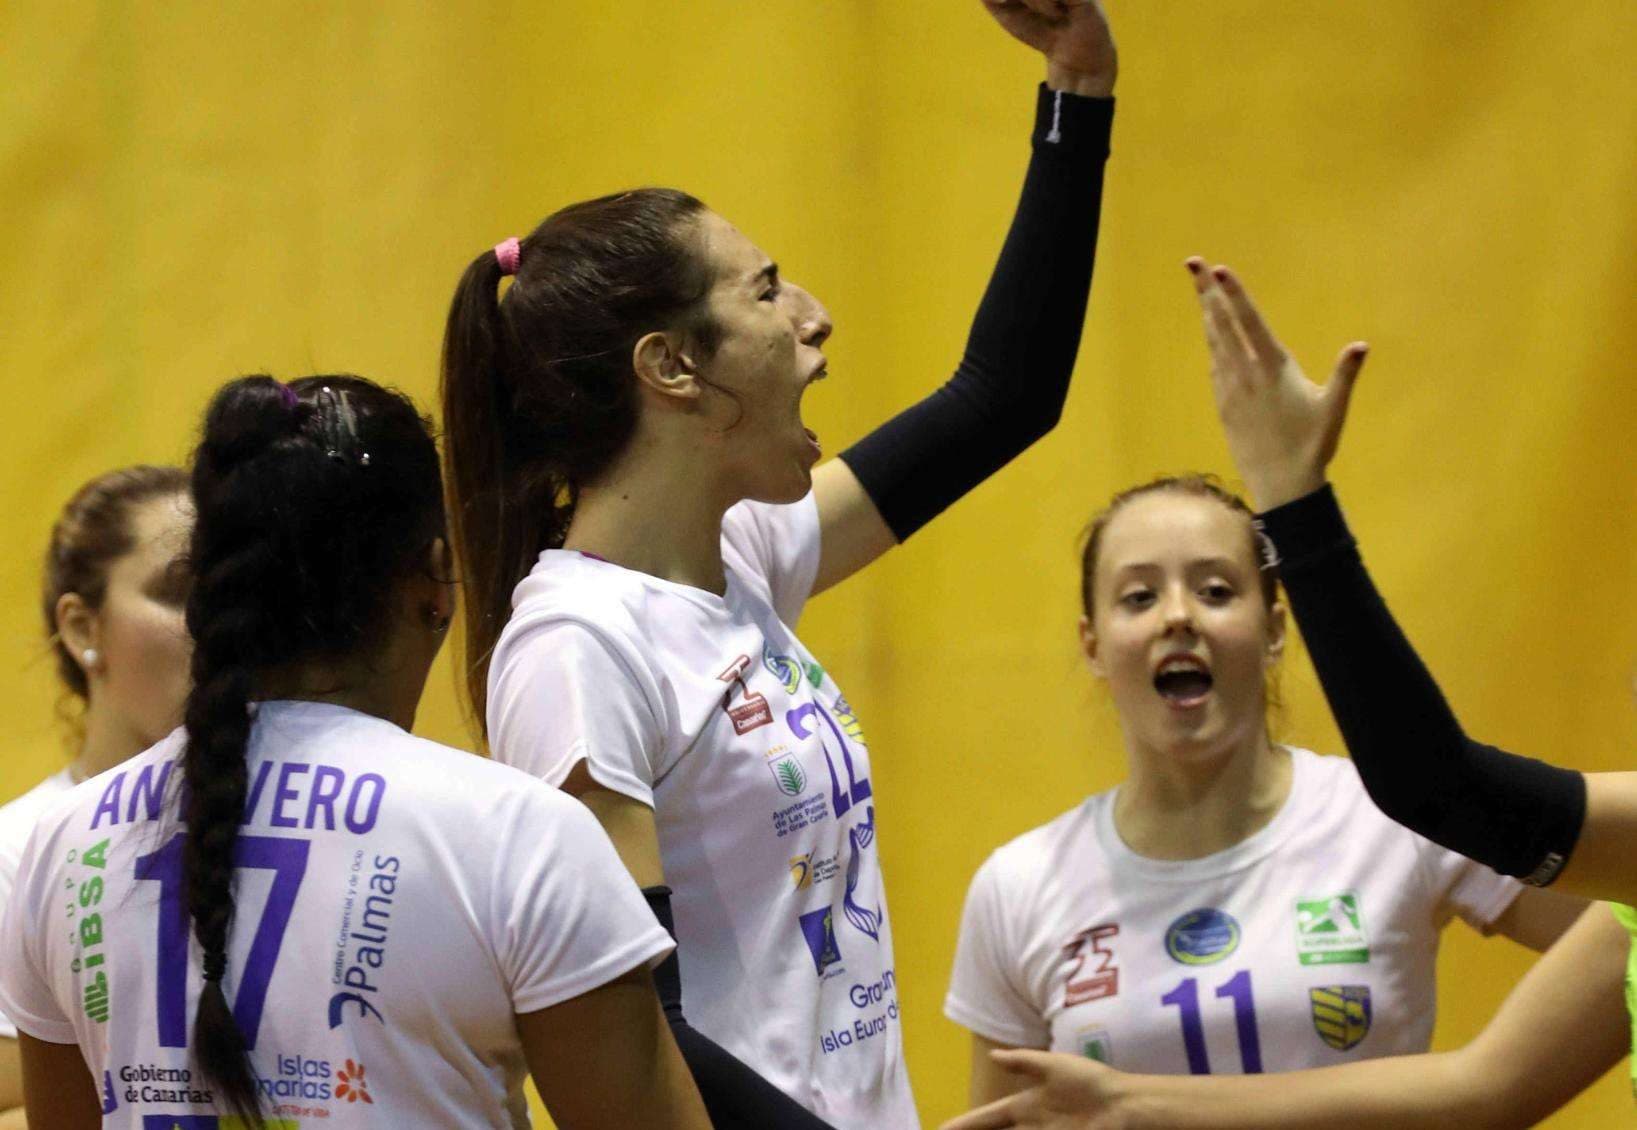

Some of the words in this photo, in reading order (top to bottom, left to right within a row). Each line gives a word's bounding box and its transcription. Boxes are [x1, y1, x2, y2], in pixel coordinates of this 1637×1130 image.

[348, 874, 359, 887] de
[336, 897, 354, 949] Comercial
[134, 832, 311, 1051] 17
[332, 950, 345, 985] Centro
[1161, 969, 1265, 1075] 11
[120, 1064, 192, 1083] Gobierno
[277, 1053, 332, 1079] Islas
[125, 1085, 139, 1104] de
